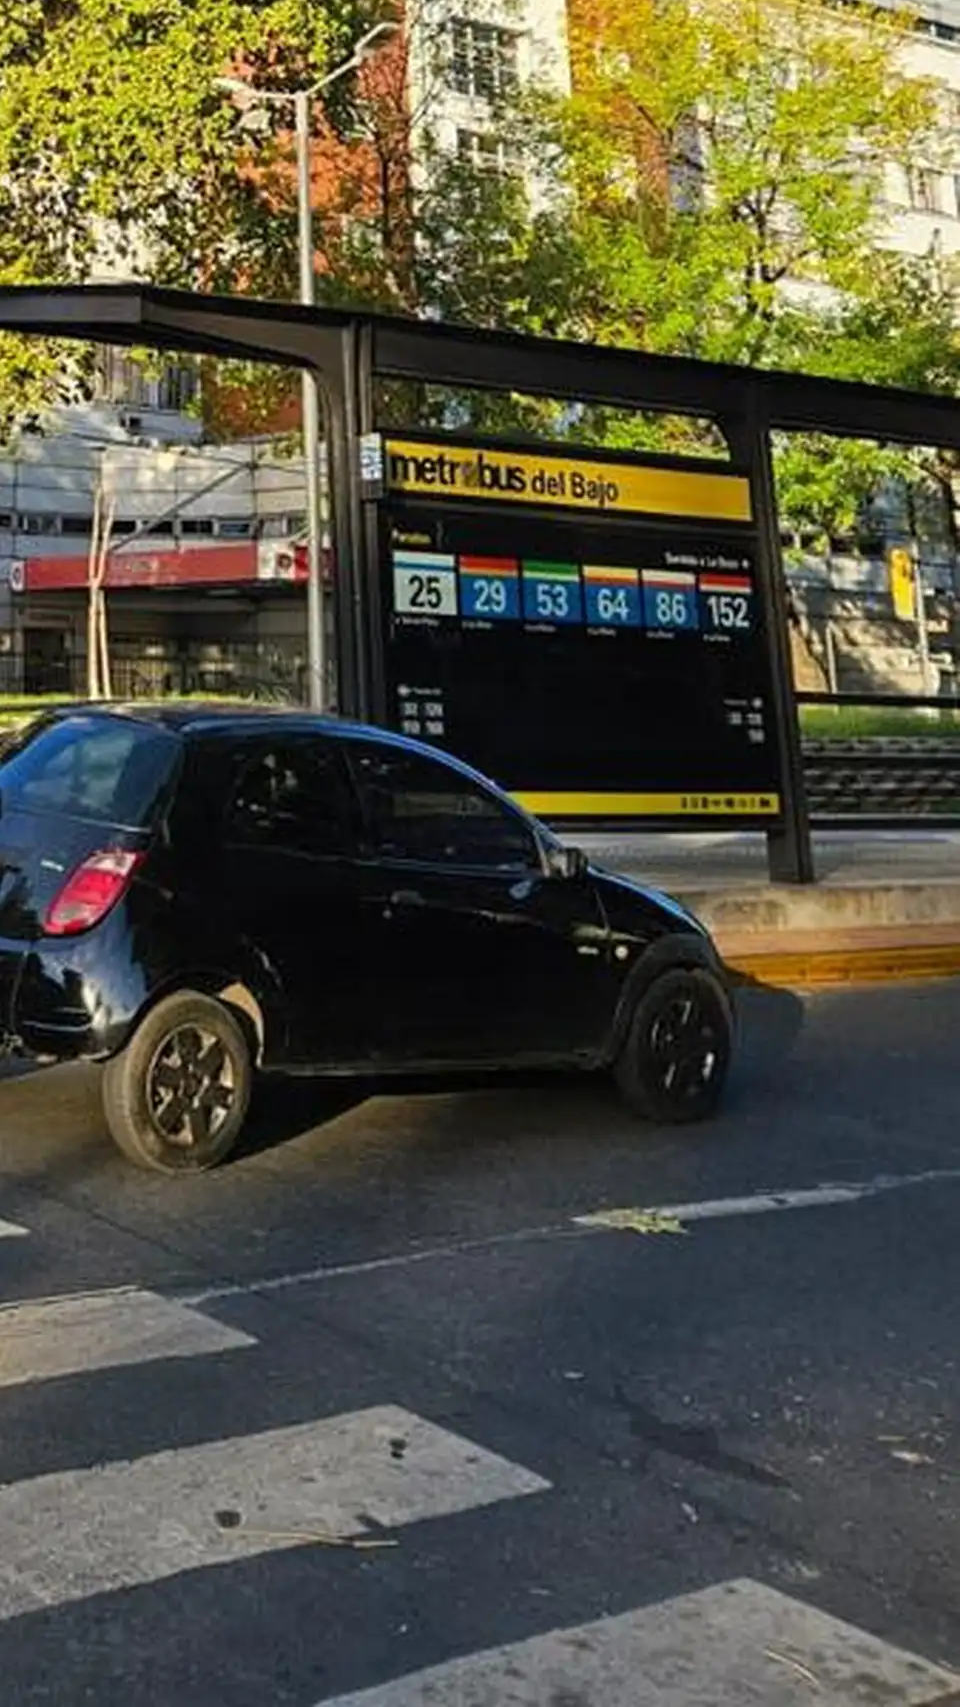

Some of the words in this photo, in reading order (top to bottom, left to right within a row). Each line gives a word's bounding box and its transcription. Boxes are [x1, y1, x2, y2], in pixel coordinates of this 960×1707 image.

[531, 467, 565, 496] del
[569, 471, 619, 507] Bajo
[409, 574, 442, 608] 25
[473, 579, 506, 613] 29
[537, 583, 569, 616] 53
[597, 588, 630, 621] 64
[656, 591, 687, 624] 86
[706, 595, 750, 628] 152
